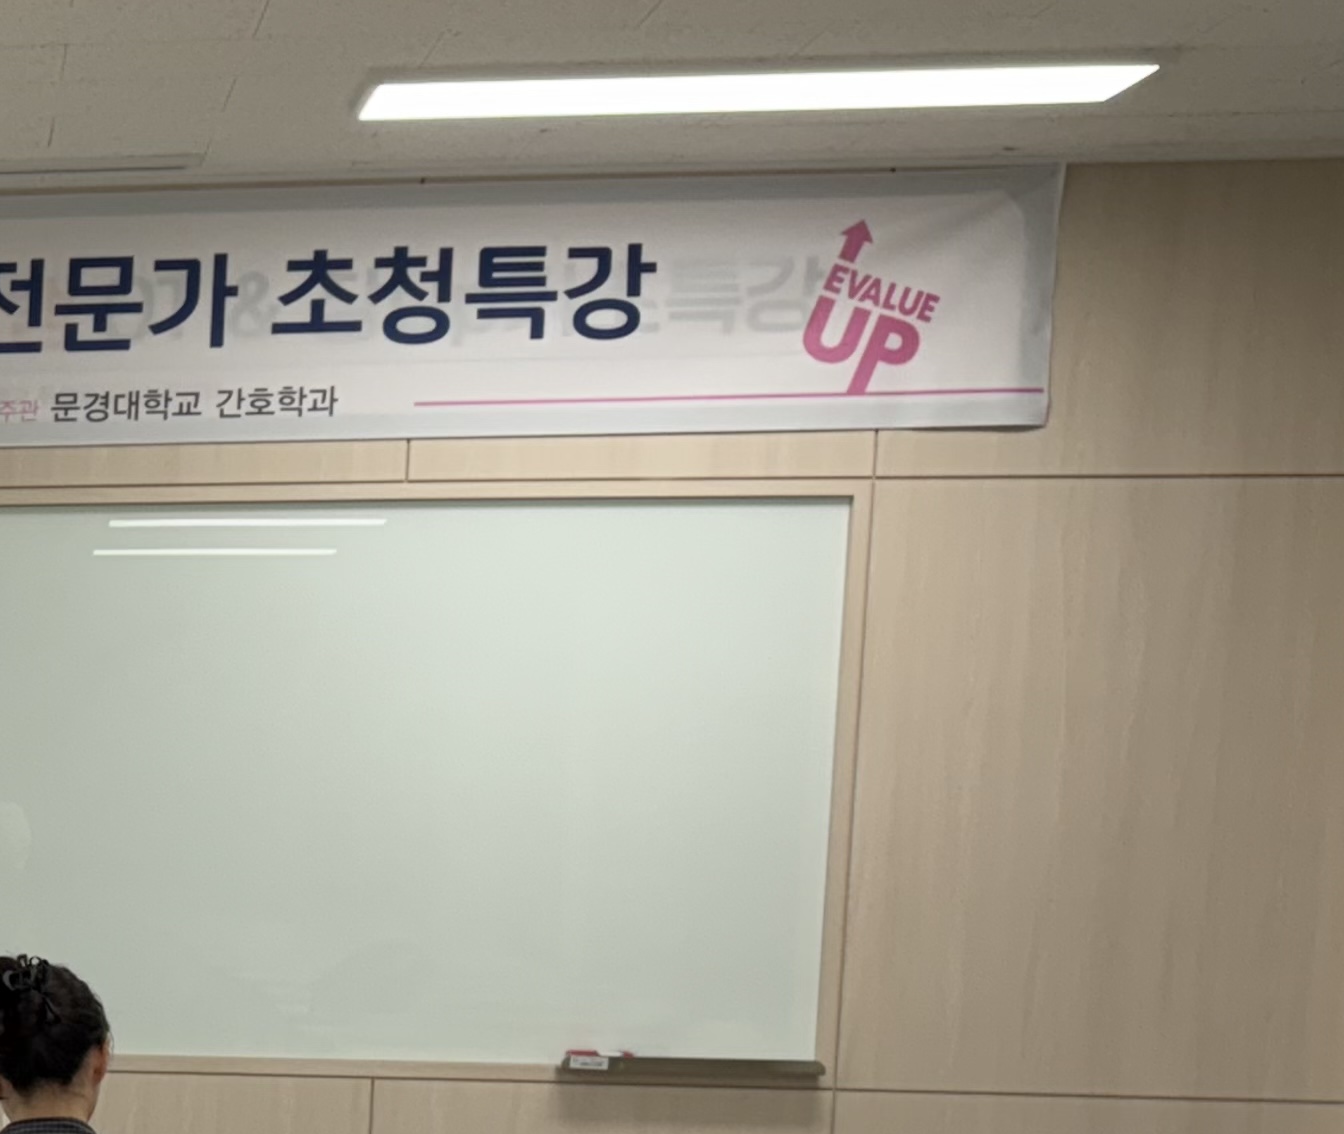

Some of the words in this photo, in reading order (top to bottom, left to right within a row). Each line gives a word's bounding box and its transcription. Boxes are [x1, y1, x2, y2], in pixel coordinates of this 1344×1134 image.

[270, 243, 657, 346] 초청특강
[823, 263, 941, 323] EVALUE
[801, 294, 922, 393] UP
[49, 388, 203, 424] 문경대학교
[214, 385, 340, 420] 간호학과
